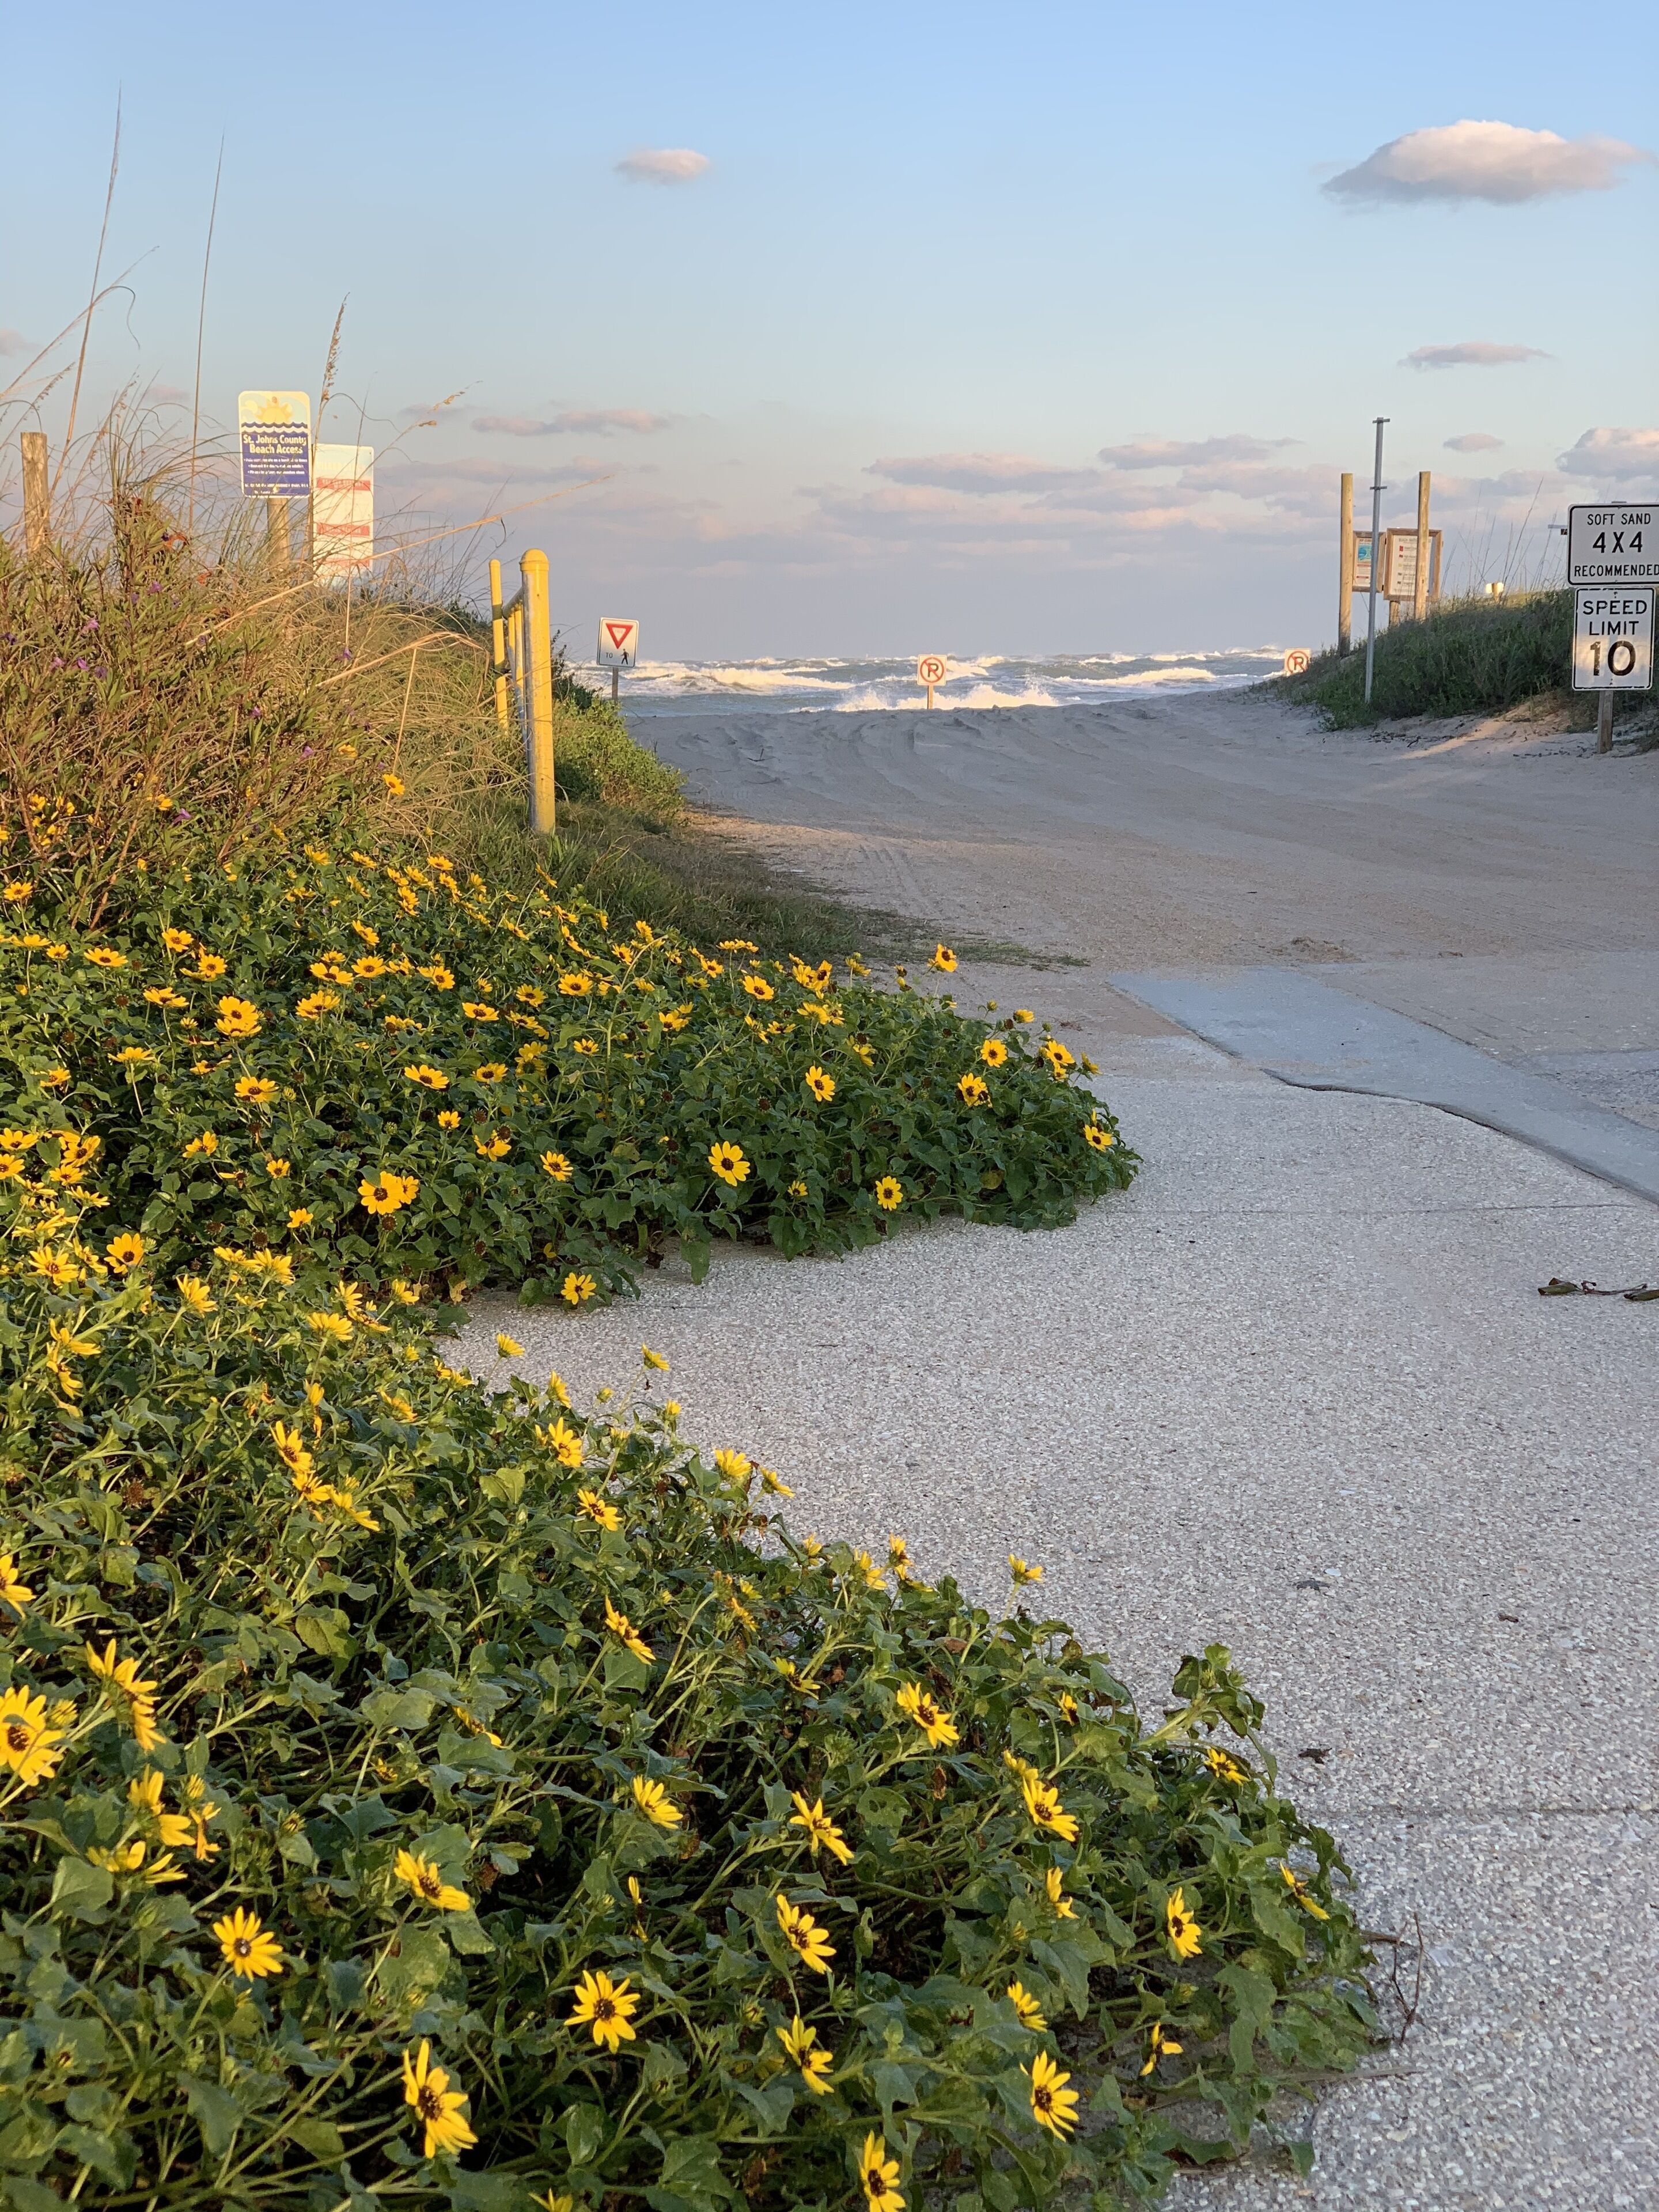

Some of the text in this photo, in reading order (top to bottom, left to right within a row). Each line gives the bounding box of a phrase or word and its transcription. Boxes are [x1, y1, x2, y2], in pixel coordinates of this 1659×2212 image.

[243, 434, 306, 446] St. Johns County
[249, 444, 303, 453] Beach Access
[1587, 513, 1651, 525] SOFT SAND
[1574, 564, 1659, 577] RECOMMENDED
[1582, 600, 1647, 615] SPEED
[1589, 621, 1639, 635] LIMIT
[1590, 640, 1636, 676] 10
